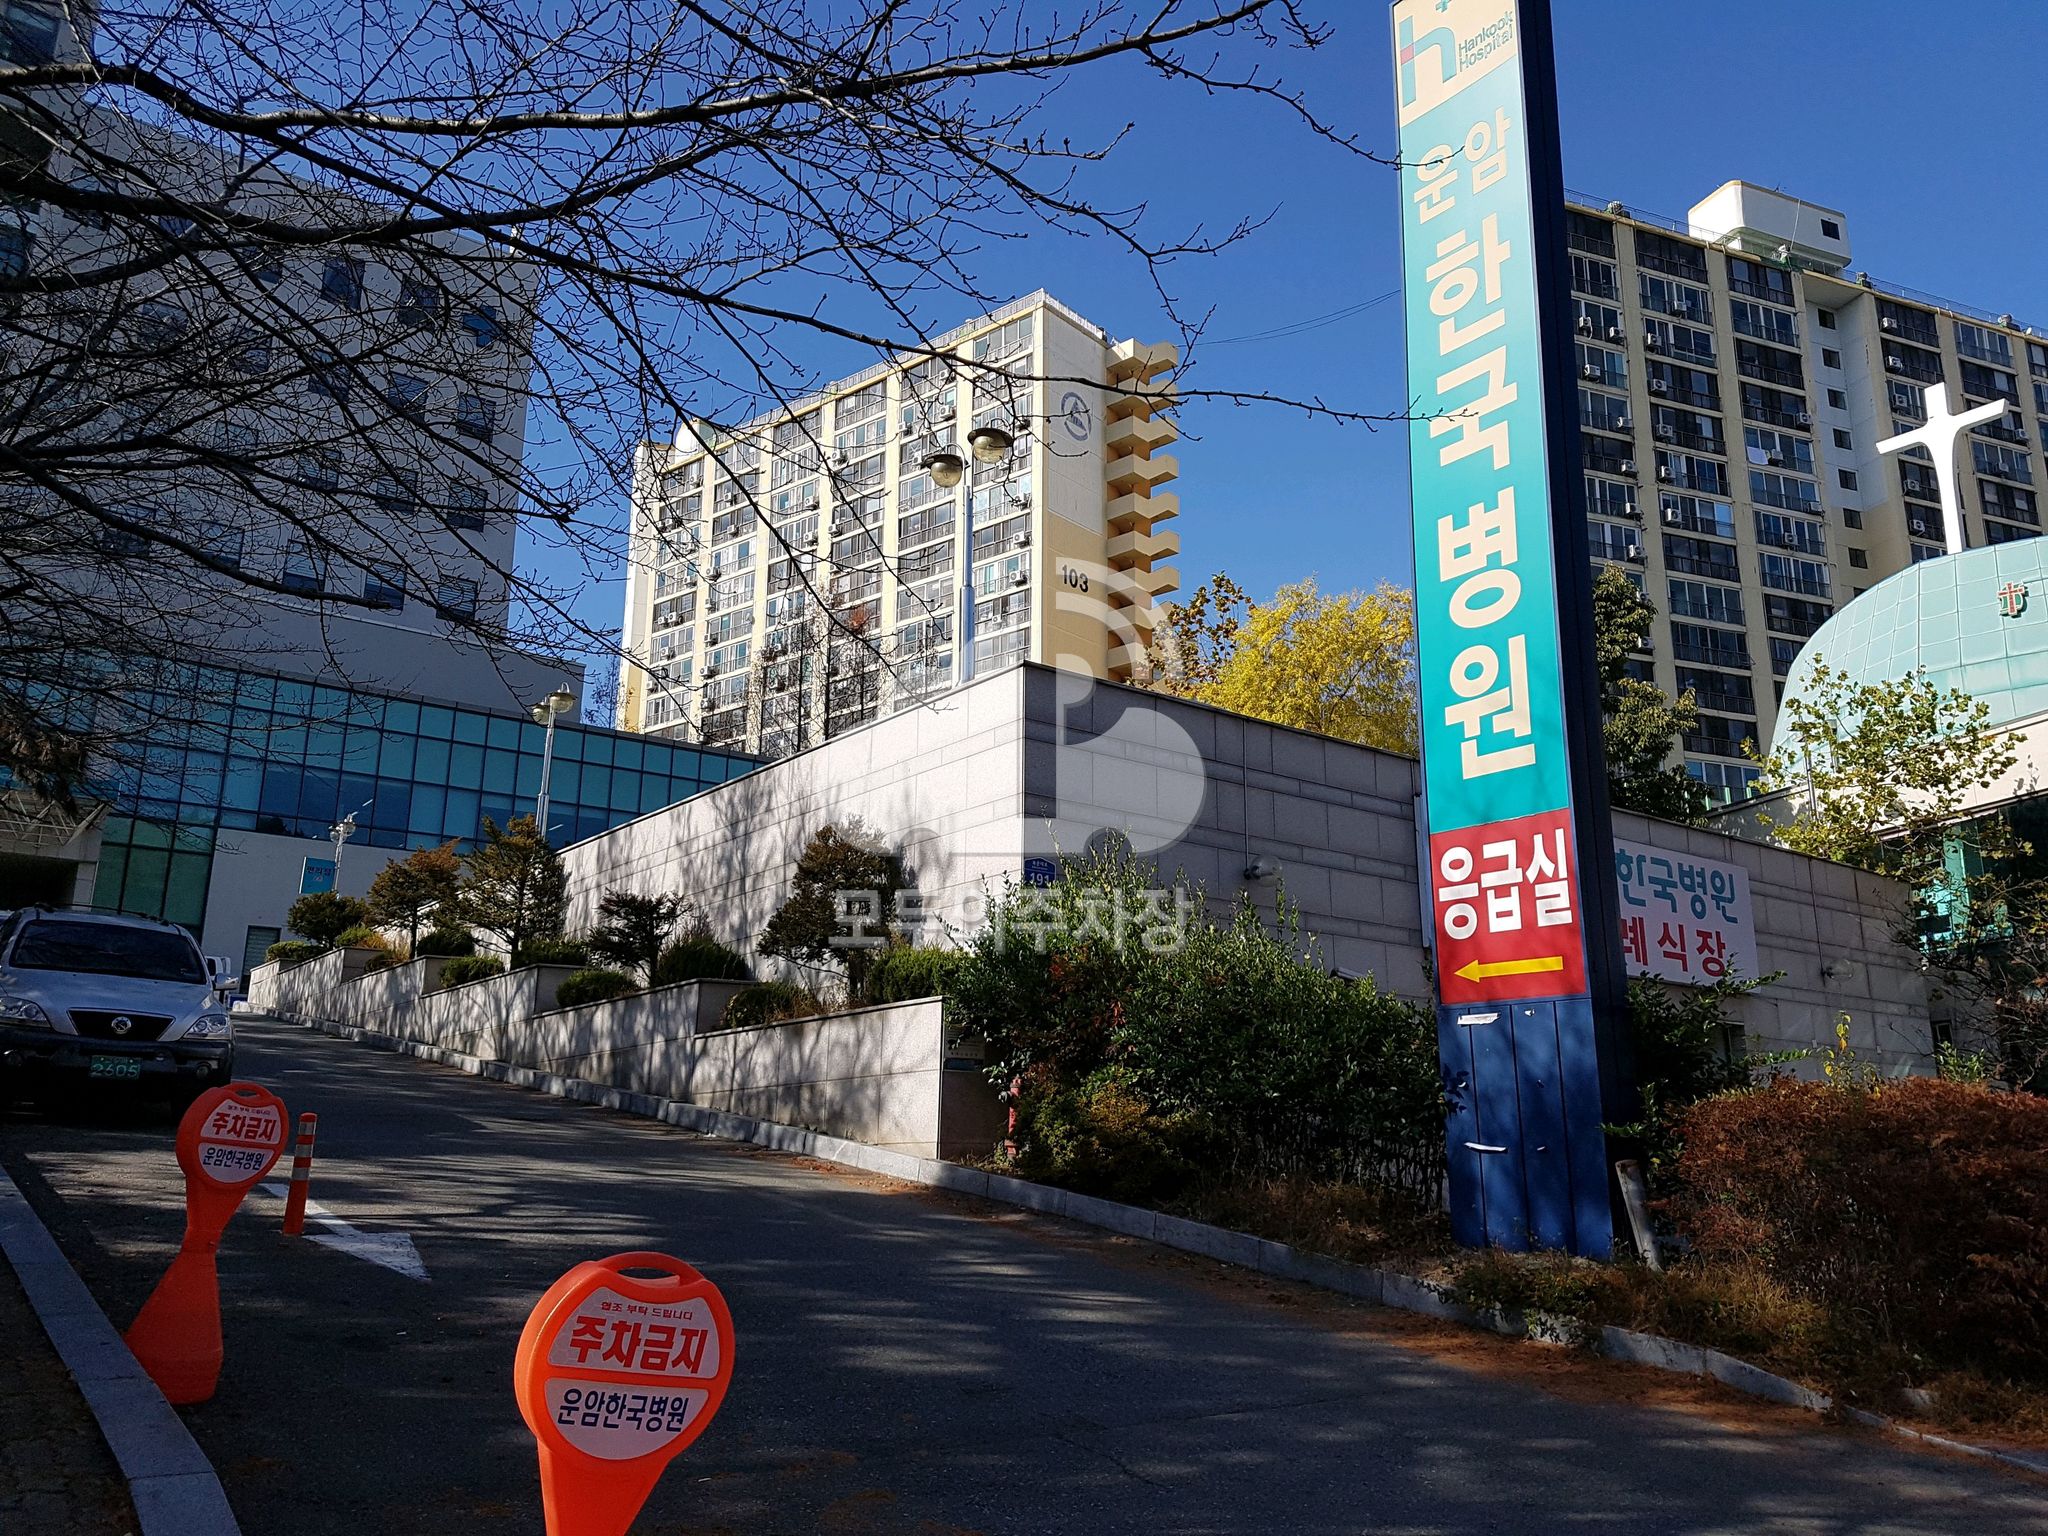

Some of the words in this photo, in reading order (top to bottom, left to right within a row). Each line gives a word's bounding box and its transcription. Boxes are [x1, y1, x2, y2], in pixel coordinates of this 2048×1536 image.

[1458, 11, 1513, 57] Hankook
[1459, 24, 1513, 72] Hospital
[1062, 564, 1089, 593] 103
[1030, 872, 1050, 886] 191
[1438, 828, 1573, 940] 응급실
[90, 1063, 138, 1077] 2605
[212, 1112, 277, 1141] 주차금지
[202, 1147, 265, 1171] 운암한국병원
[601, 1301, 623, 1313] 협조
[627, 1303, 648, 1316] 부탁
[652, 1307, 693, 1320] 드립니다
[570, 1315, 709, 1374] 주차금지
[557, 1388, 690, 1432] 운암한국병원
